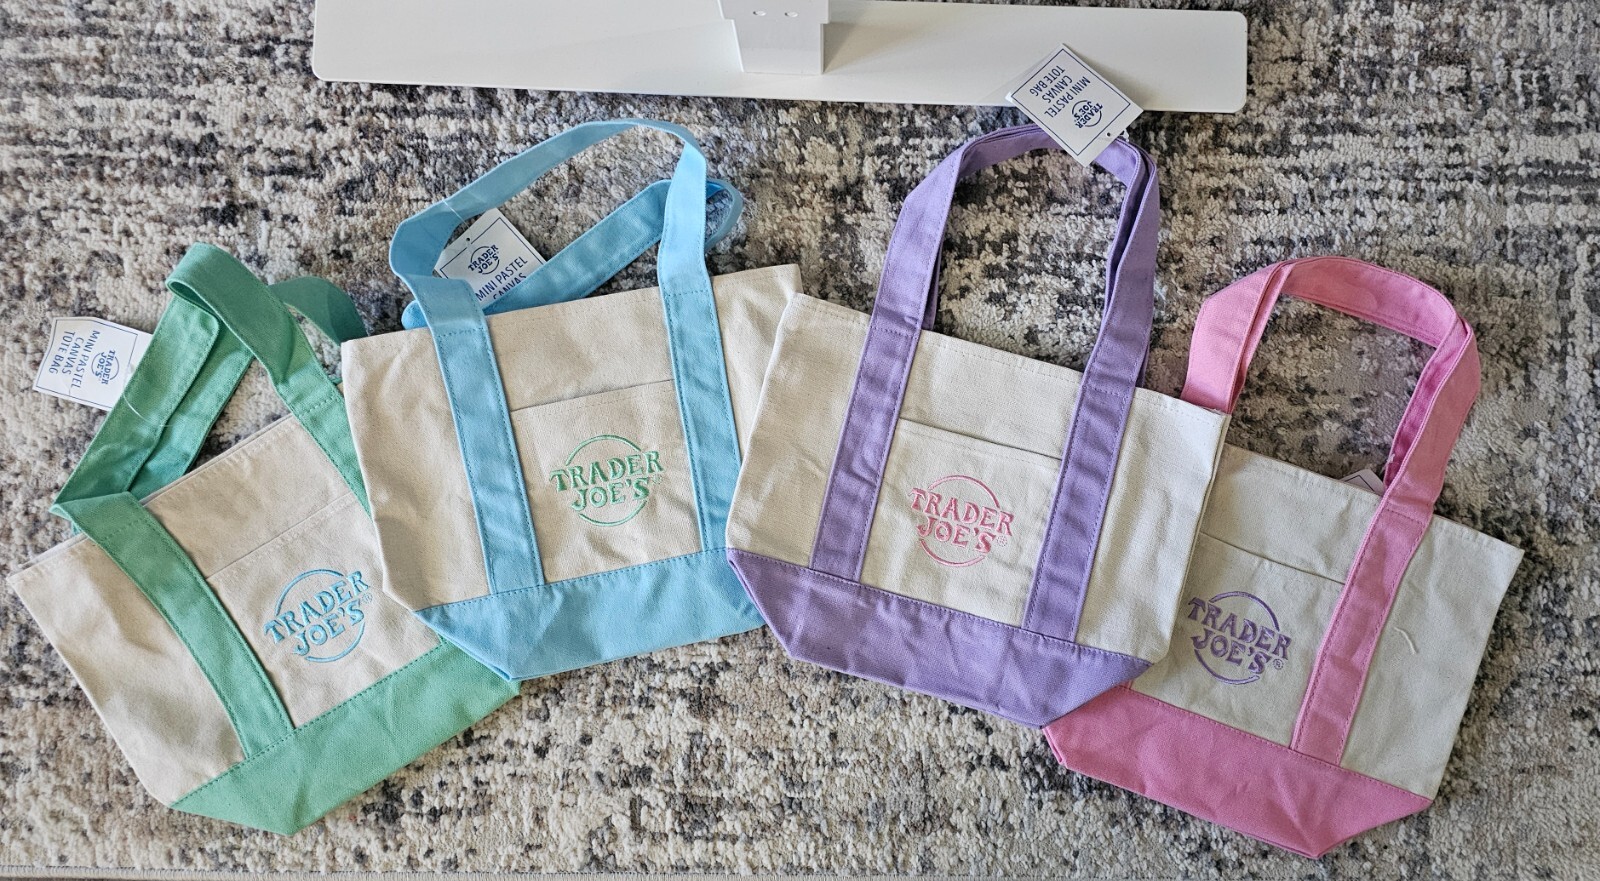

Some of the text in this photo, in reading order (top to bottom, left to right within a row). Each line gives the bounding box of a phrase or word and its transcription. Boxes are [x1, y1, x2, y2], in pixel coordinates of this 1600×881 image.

[1030, 65, 1065, 96] TOTE BAG
[1042, 76, 1072, 104] CANVAS
[1044, 76, 1091, 118] MINI PASTEL
[1075, 102, 1103, 128] TRADER
[468, 244, 499, 271] TRADER
[475, 256, 528, 301] MINI PASTEL
[49, 330, 76, 374] TOTE BAG
[62, 337, 84, 375] CANVAS
[70, 330, 100, 388] MINI PASTEL
[101, 349, 116, 385] TRADER
[549, 450, 664, 492] TRADER
[908, 487, 1014, 536] TRADER
[264, 570, 370, 644] TRADER
[1188, 597, 1292, 660] TRADER
